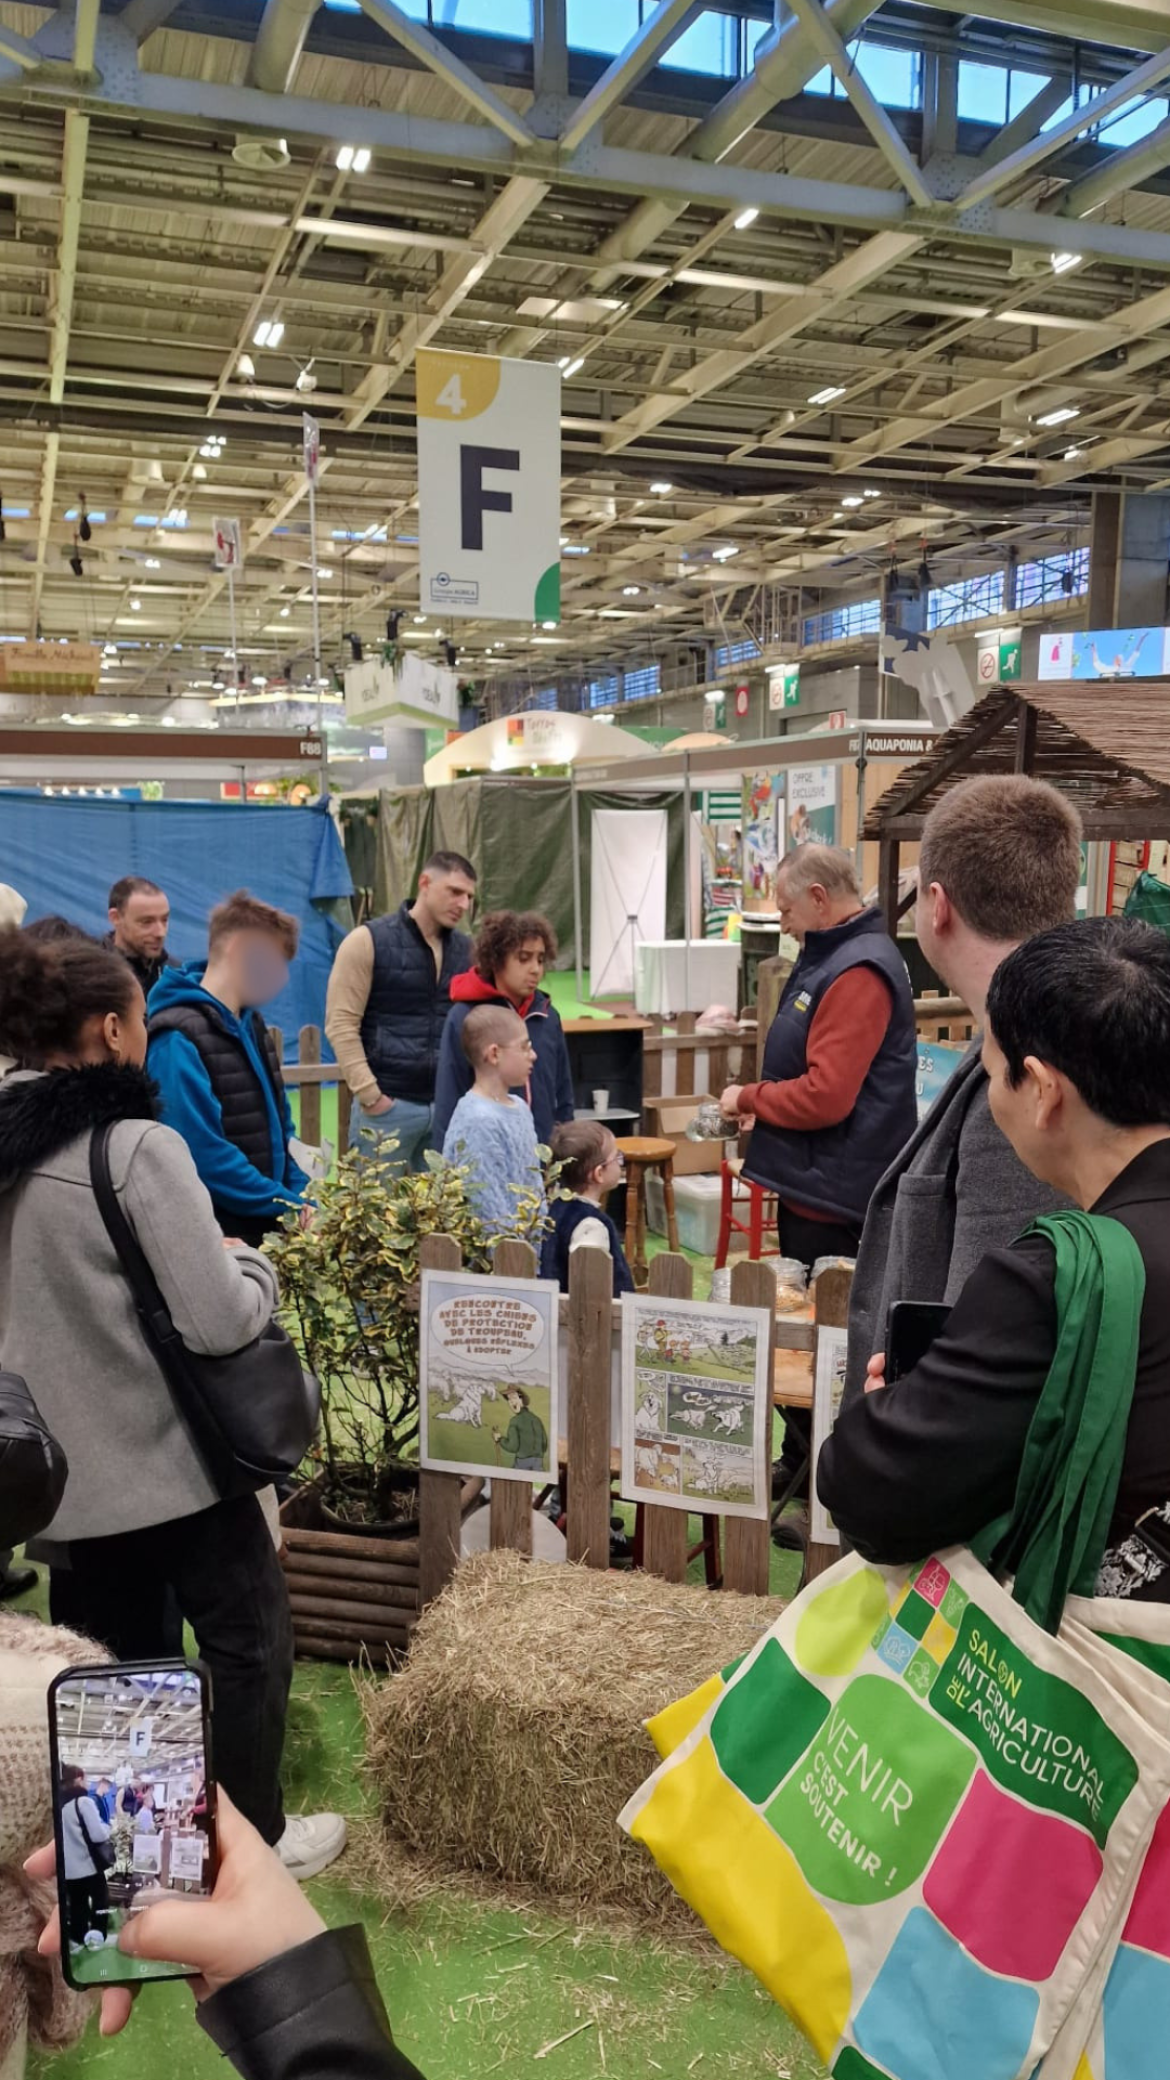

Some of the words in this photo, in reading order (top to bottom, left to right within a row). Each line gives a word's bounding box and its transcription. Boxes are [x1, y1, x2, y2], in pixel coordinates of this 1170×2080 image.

[435, 373, 467, 416] 4
[460, 444, 520, 551] F
[866, 738, 924, 752] AQUAPONIA
[439, 1310, 467, 1319] AVEC
[469, 1309, 493, 1317] LES
[495, 1310, 537, 1323] CHIENS
[453, 1300, 521, 1311] RENCONTRE
[444, 1320, 458, 1328] DE
[462, 1318, 533, 1331] PROTECTION
[450, 1328, 465, 1336] DE
[969, 1629, 1022, 1699] SALON
[946, 1675, 963, 1700] DE
[136, 1731, 146, 1747] F
[957, 1653, 1104, 1804] INTERNATIONAL
[814, 1751, 849, 1807] C'EST
[827, 1708, 913, 1827] VENIR
[800, 1772, 882, 1878] SOUTENIR
